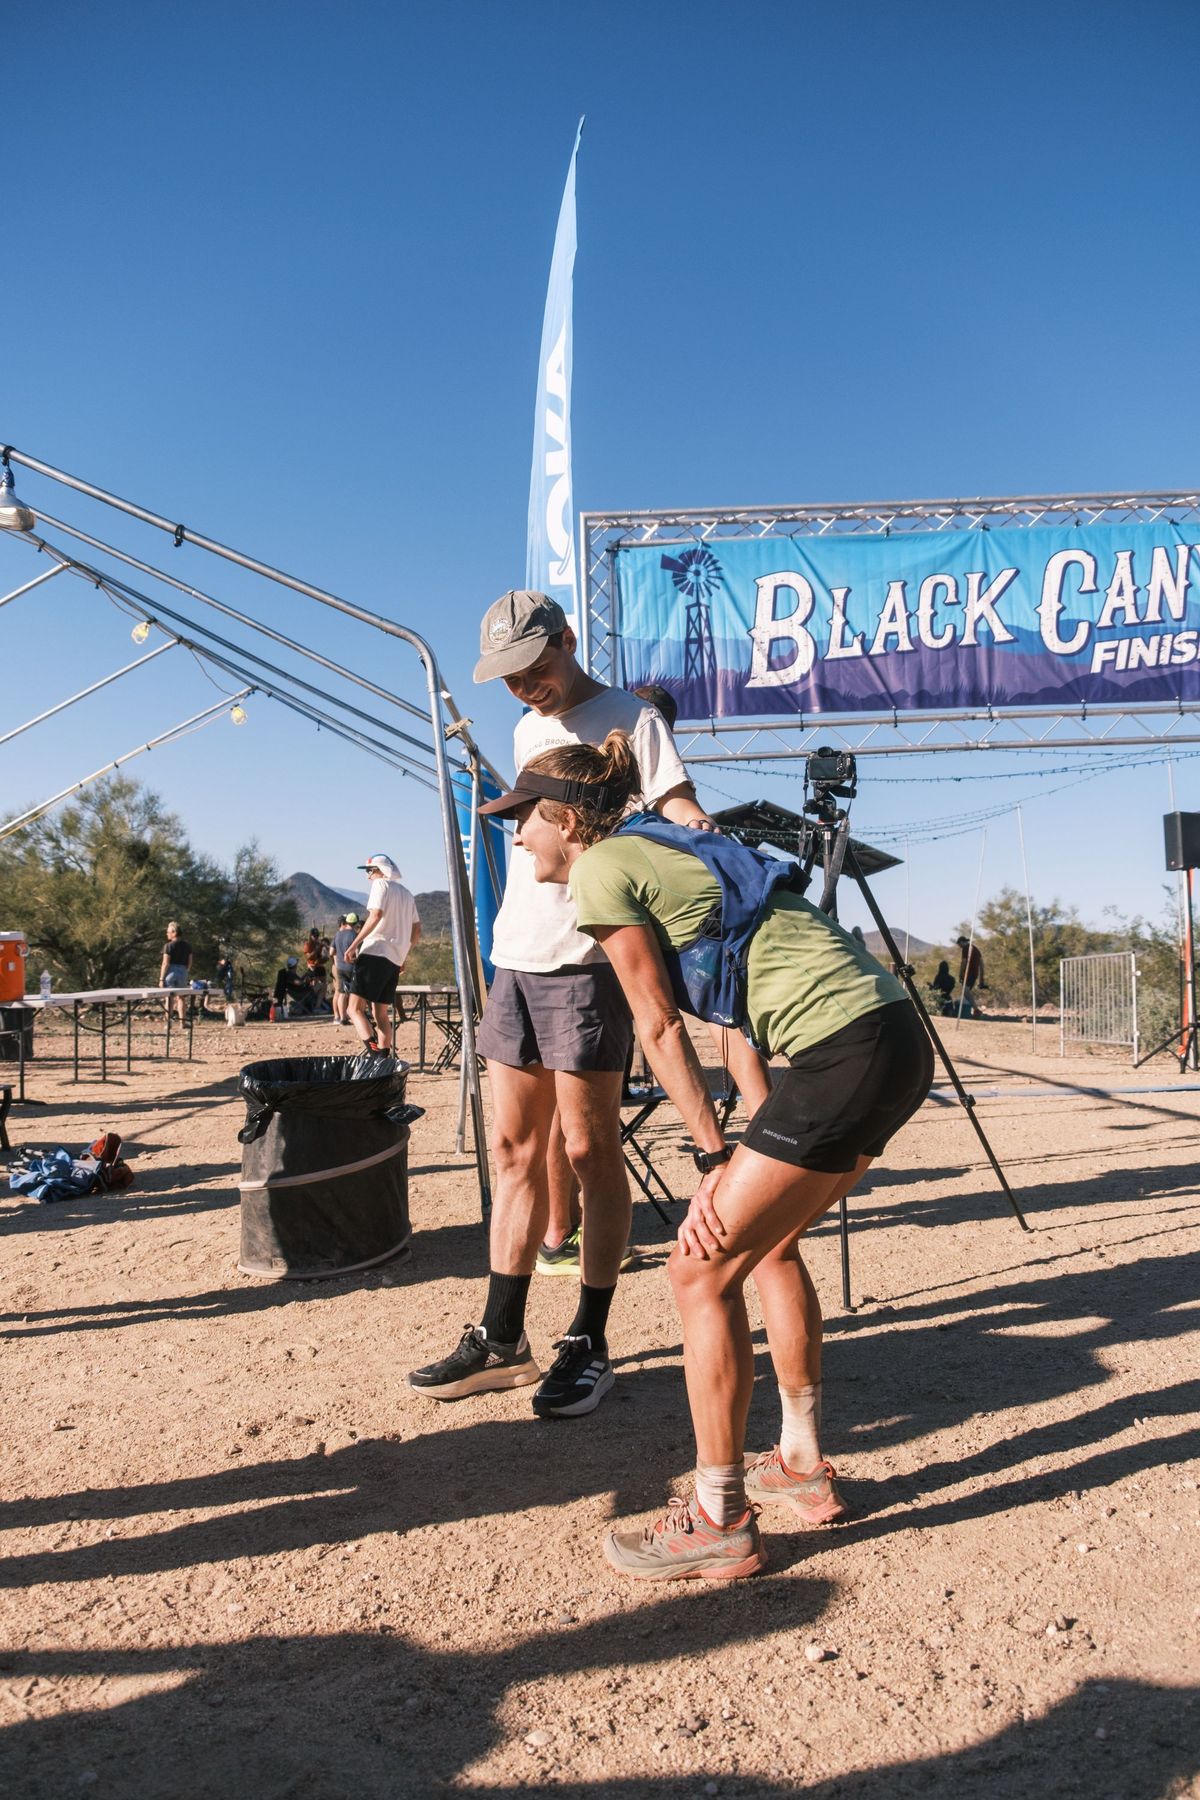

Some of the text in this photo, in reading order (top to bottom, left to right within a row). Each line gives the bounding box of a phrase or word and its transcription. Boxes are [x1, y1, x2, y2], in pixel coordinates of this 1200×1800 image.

[745, 543, 1200, 689] BLACK CAN
[1090, 630, 1200, 674] FINIS
[762, 1128, 798, 1145] patagonia
